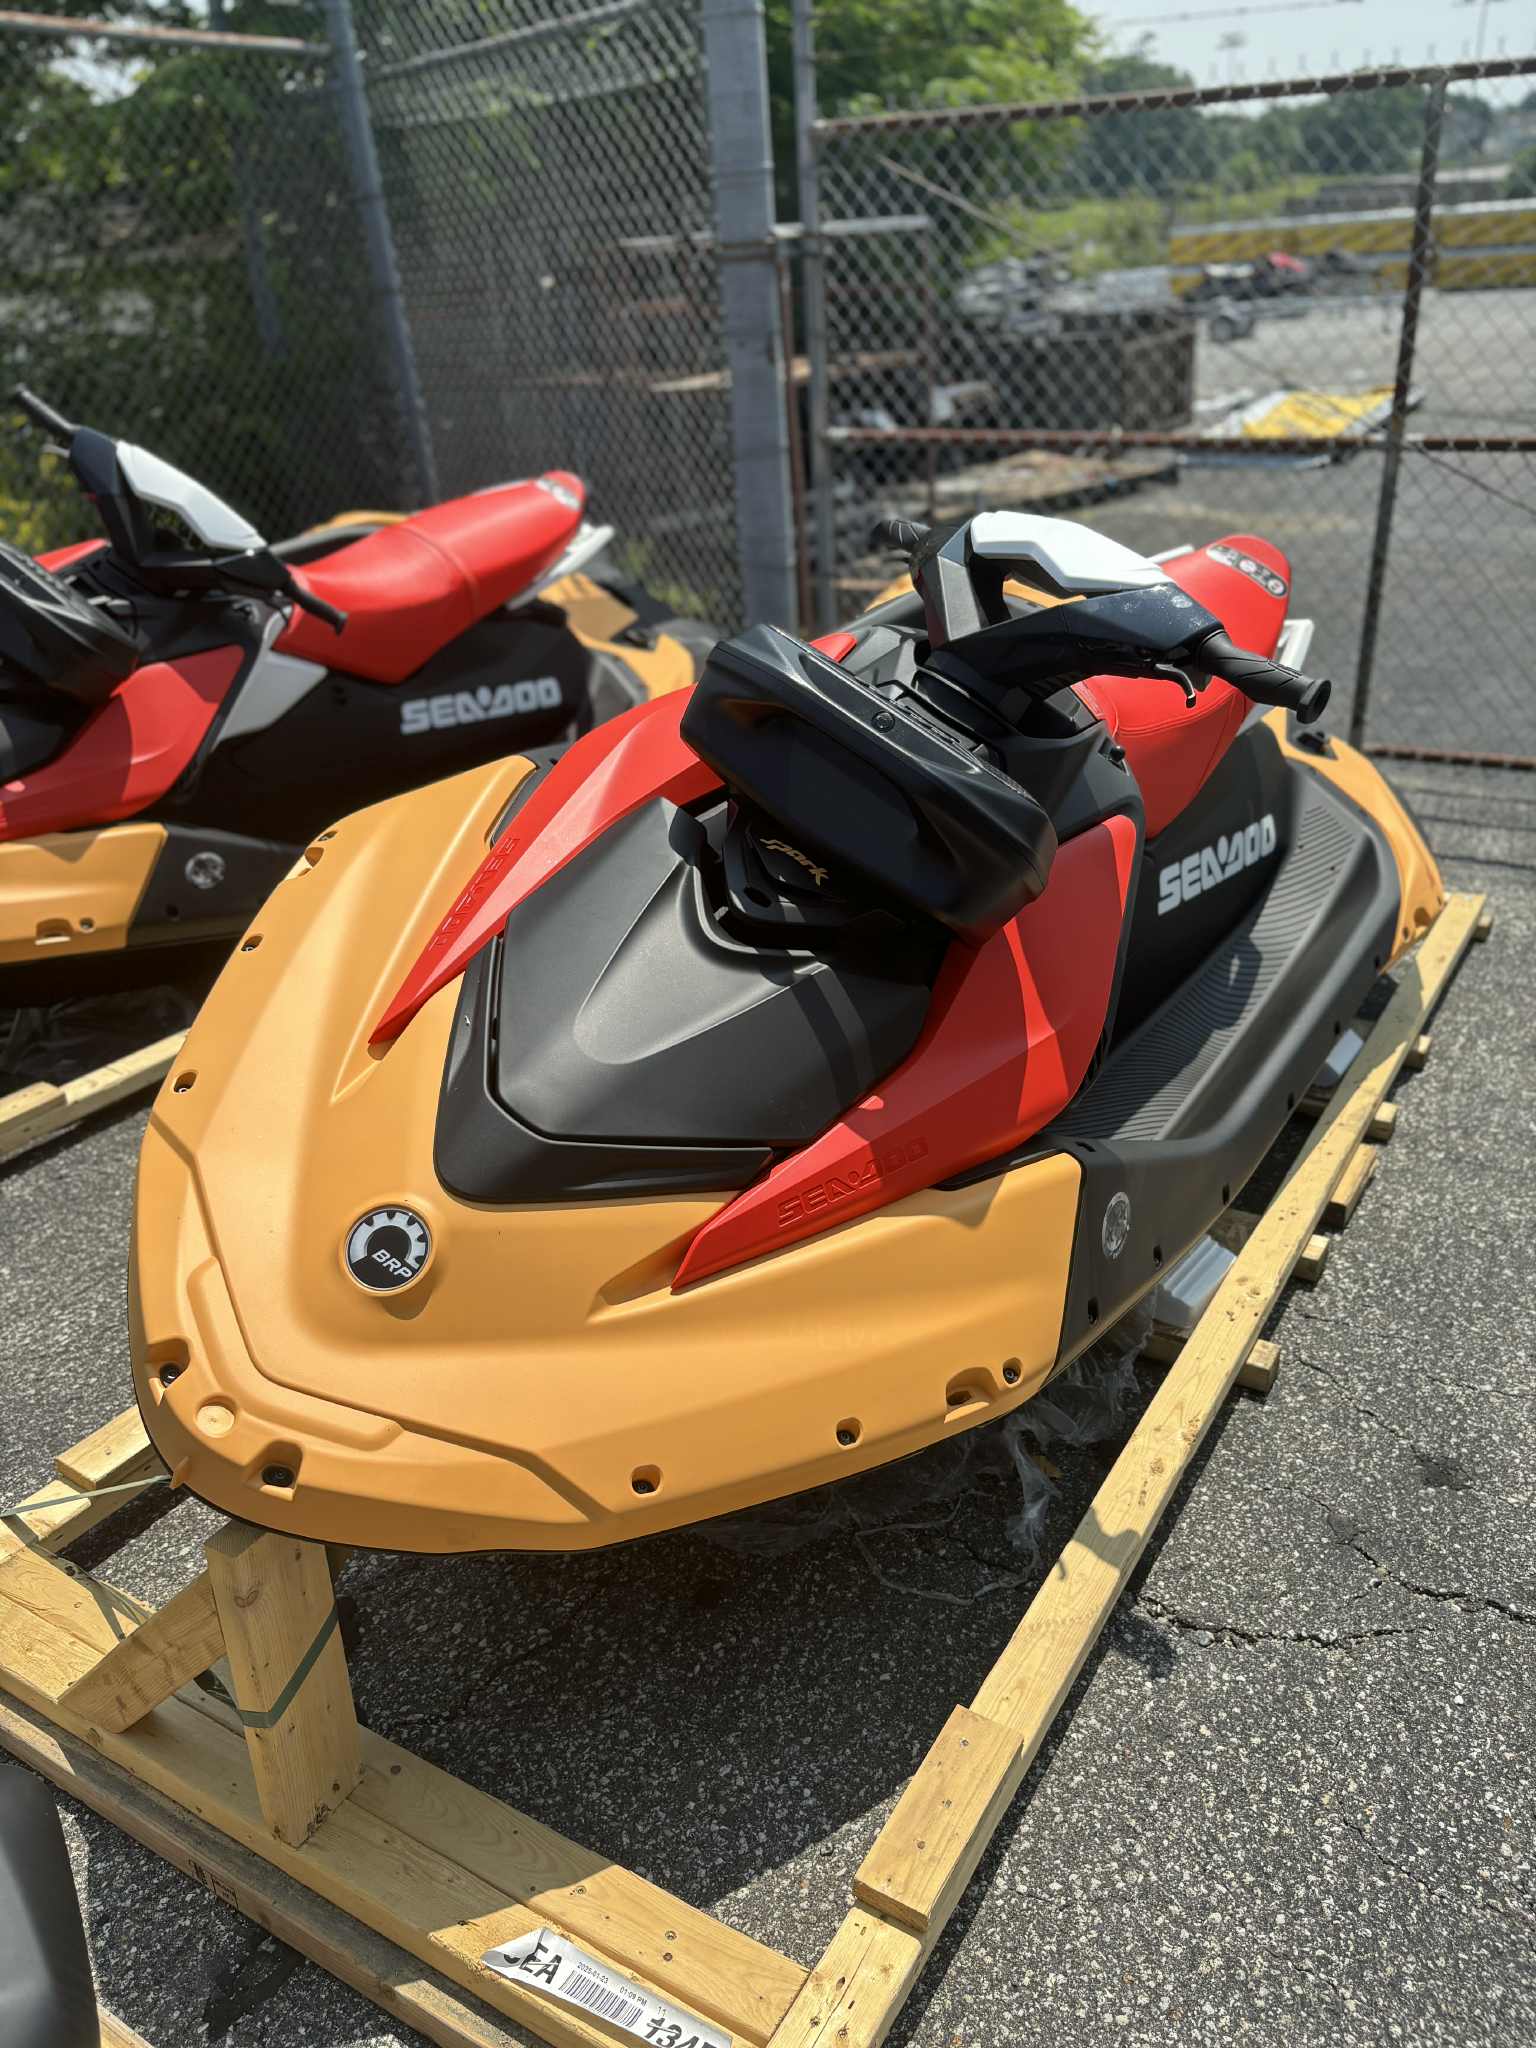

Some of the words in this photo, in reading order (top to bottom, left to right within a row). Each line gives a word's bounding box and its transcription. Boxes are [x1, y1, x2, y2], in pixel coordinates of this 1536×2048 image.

[760, 838, 829, 886] spark
[371, 1248, 413, 1278] BRP
[577, 1961, 609, 1985] 2025-01-23
[620, 1986, 637, 2000] 01:09
[637, 1996, 648, 2006] PM
